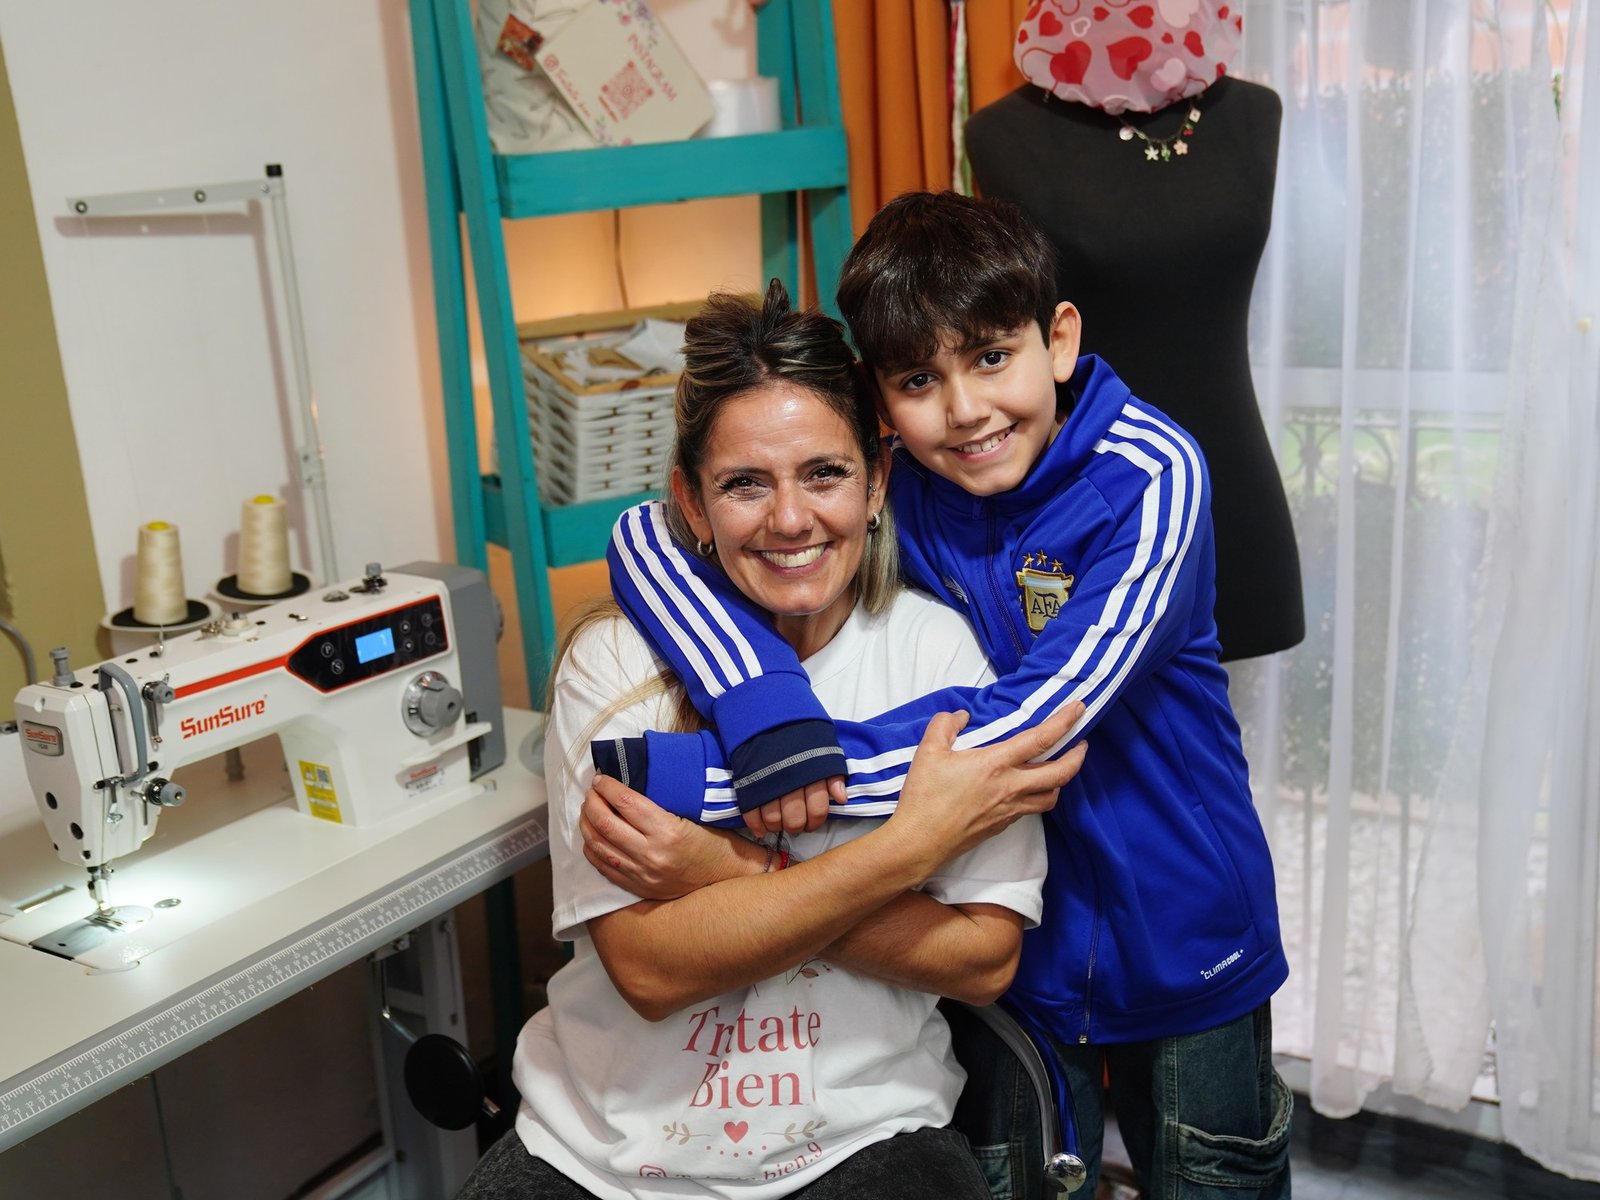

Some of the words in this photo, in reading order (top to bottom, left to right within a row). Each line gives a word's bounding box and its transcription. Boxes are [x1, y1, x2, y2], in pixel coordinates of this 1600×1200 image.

[180, 700, 265, 739] SunSure
[682, 1005, 821, 1057] Trtate
[689, 1060, 803, 1110] Bien
